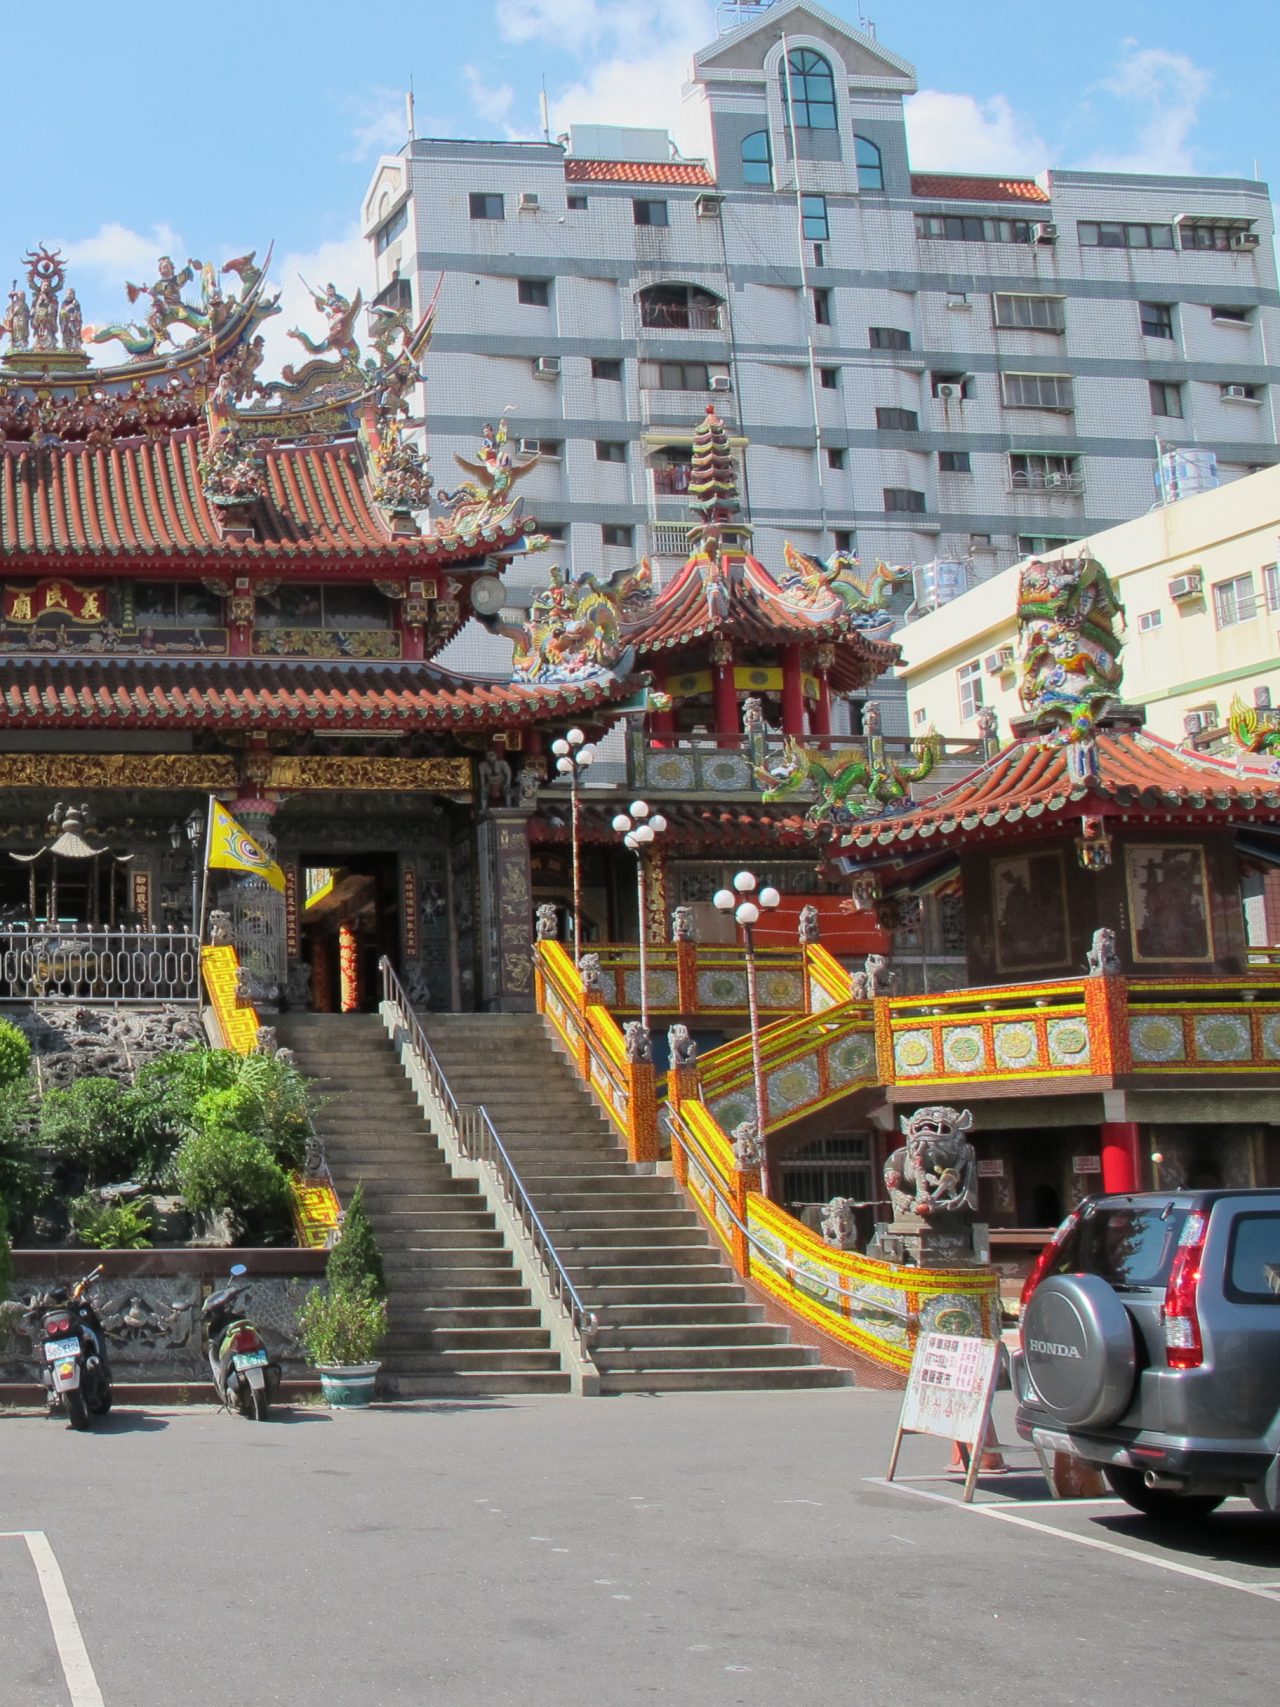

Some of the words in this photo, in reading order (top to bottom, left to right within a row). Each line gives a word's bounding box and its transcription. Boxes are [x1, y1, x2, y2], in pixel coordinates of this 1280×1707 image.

[11, 582, 102, 619] 義民廟
[1030, 1339, 1082, 1359] HONDA
